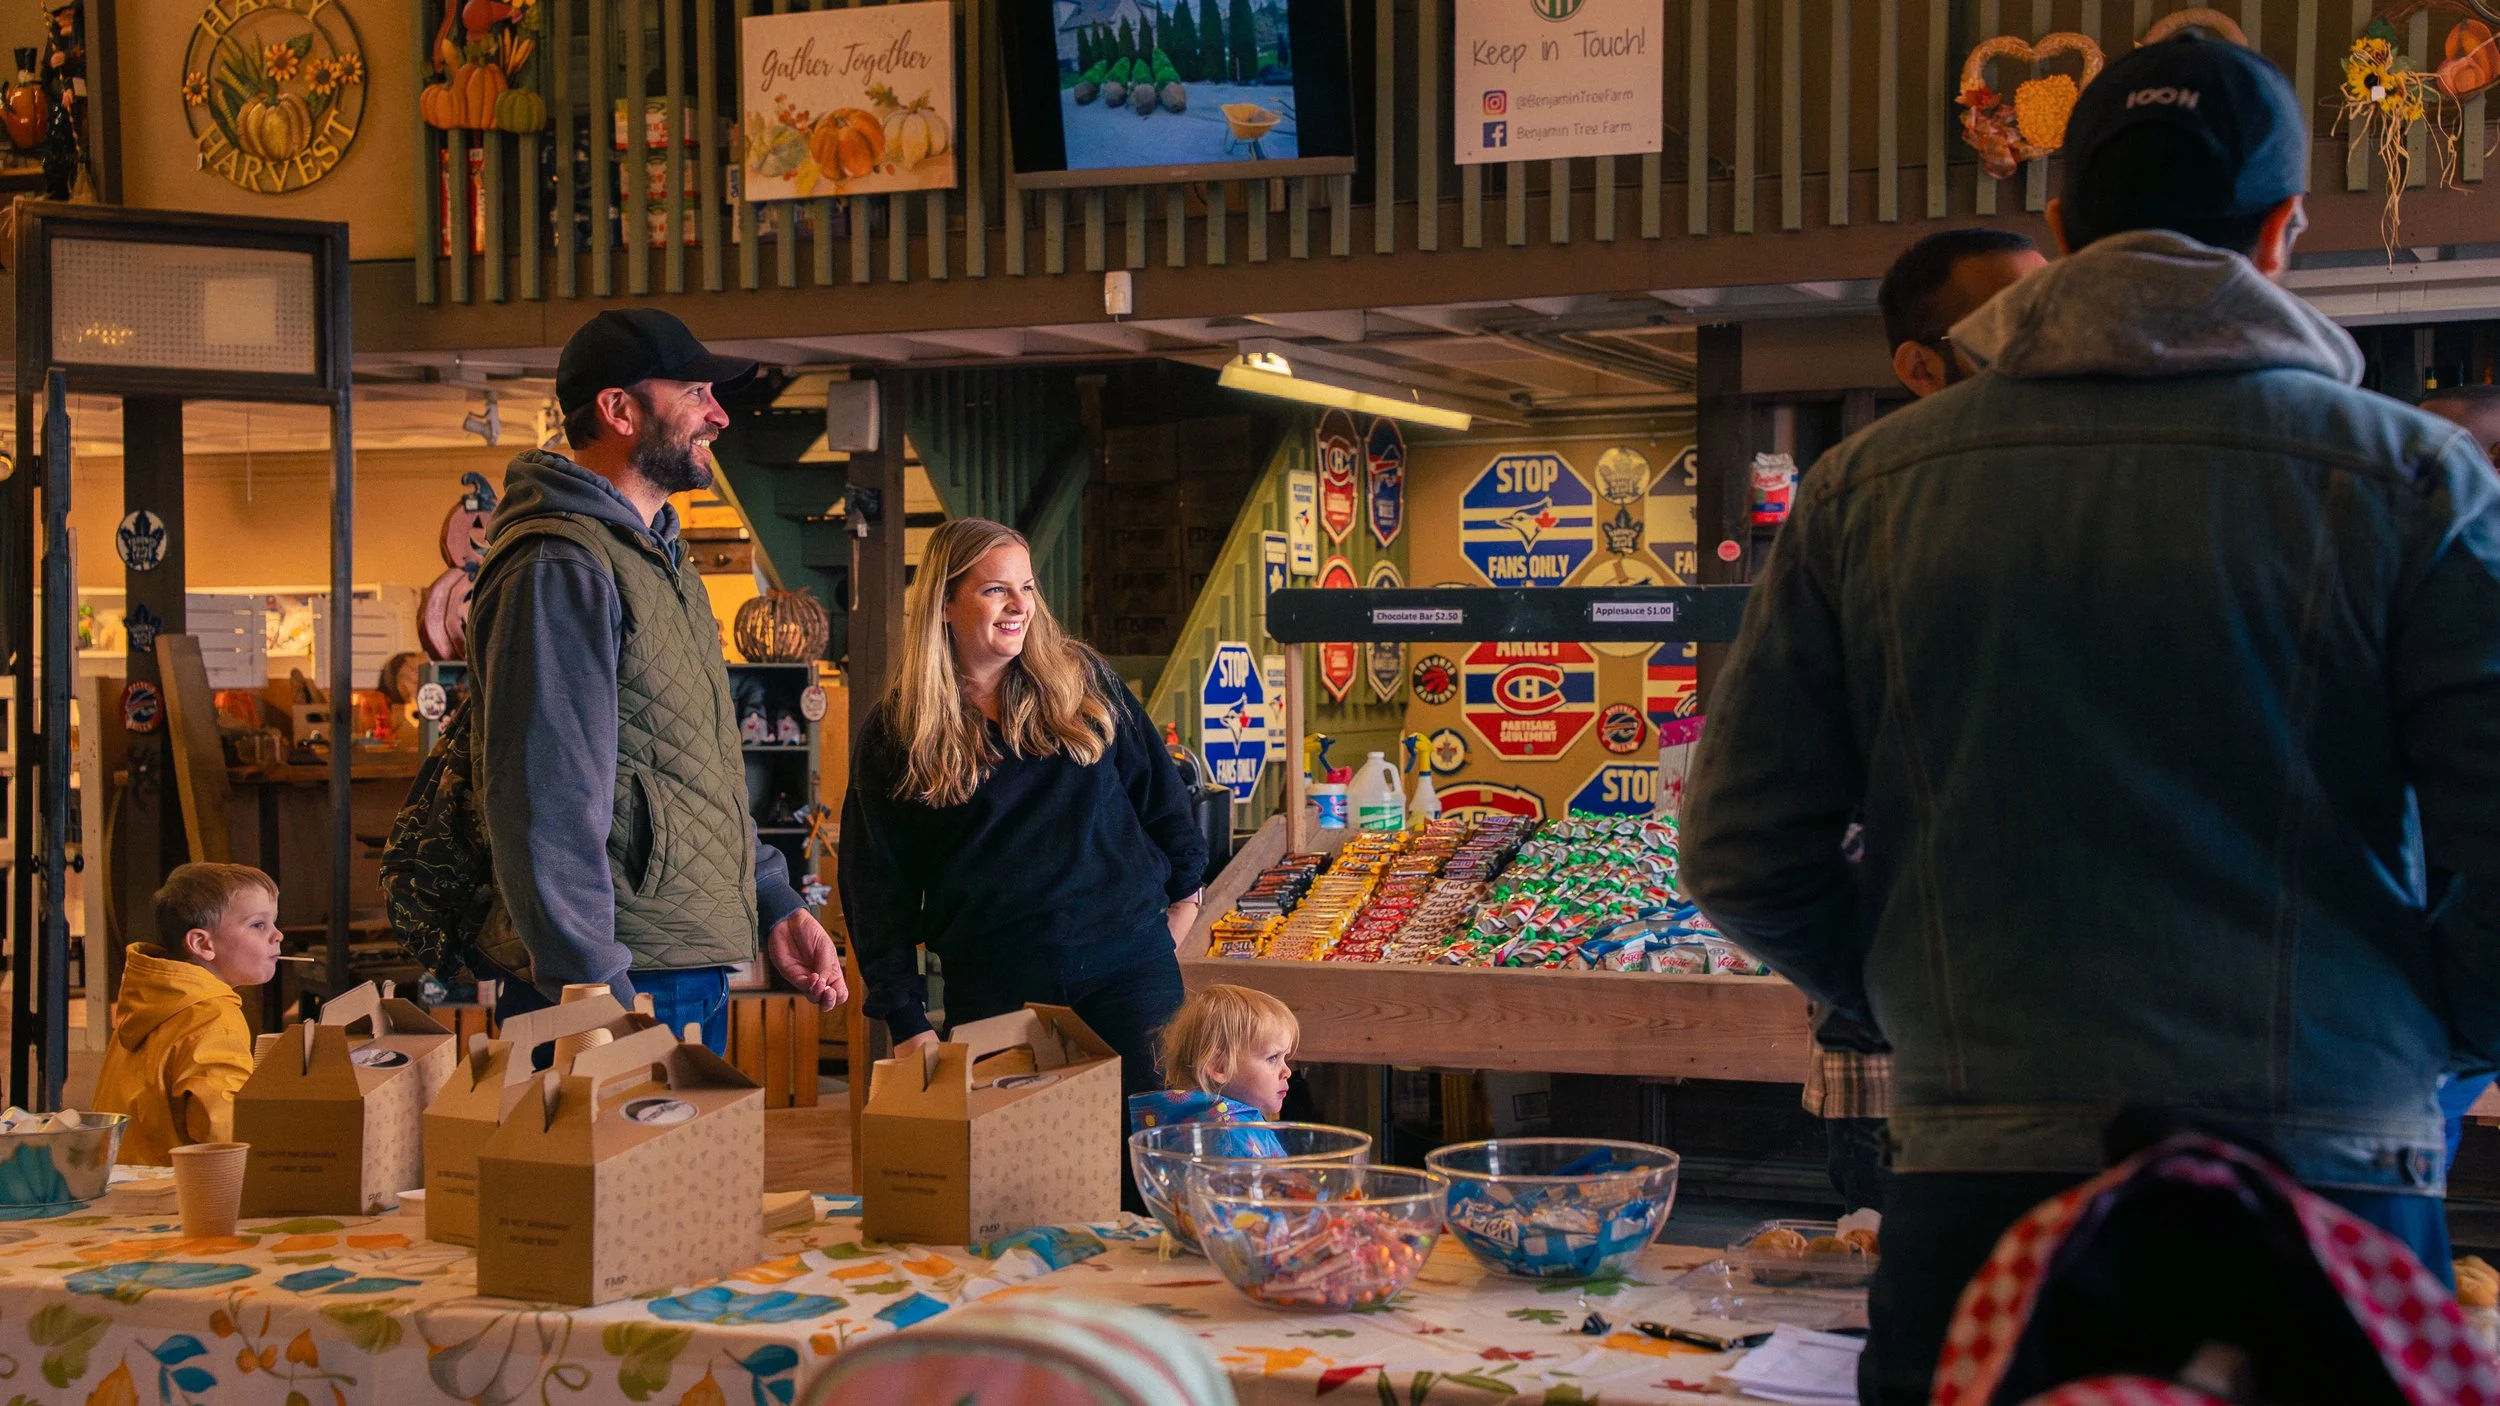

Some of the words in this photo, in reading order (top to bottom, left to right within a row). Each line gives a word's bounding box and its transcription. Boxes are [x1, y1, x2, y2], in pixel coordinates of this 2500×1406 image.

[761, 36, 834, 92] Gather
[839, 29, 932, 86] Together
[1472, 39, 1527, 73] Keep
[1541, 34, 1559, 61] in
[1574, 26, 1646, 58] Touch!
[1516, 88, 1634, 110] @BenjaminTreeFarm
[1516, 125, 1569, 142] Benjamin
[1573, 122, 1599, 136] Tree
[1602, 120, 1632, 134] Farm
[194, 109, 354, 193] HARVEST
[1496, 459, 1559, 494] STOP
[1488, 556, 1527, 579] FANS
[1529, 554, 1570, 578] ONLY
[1377, 611, 1418, 621] Chocolate
[1420, 612, 1433, 621] Bar
[1435, 611, 1458, 621] $2.50
[1595, 606, 1645, 617] Applesauce
[1647, 605, 1671, 616] $1.00
[1219, 651, 1250, 688] STOP
[1500, 720, 1556, 731] PARTISANS
[1500, 731, 1557, 743] SEULEMENT
[1217, 759, 1237, 783] FANS
[1237, 758, 1257, 783] ONLY
[1441, 881, 1471, 891] Aero
[604, 1274, 627, 1289] FMP
